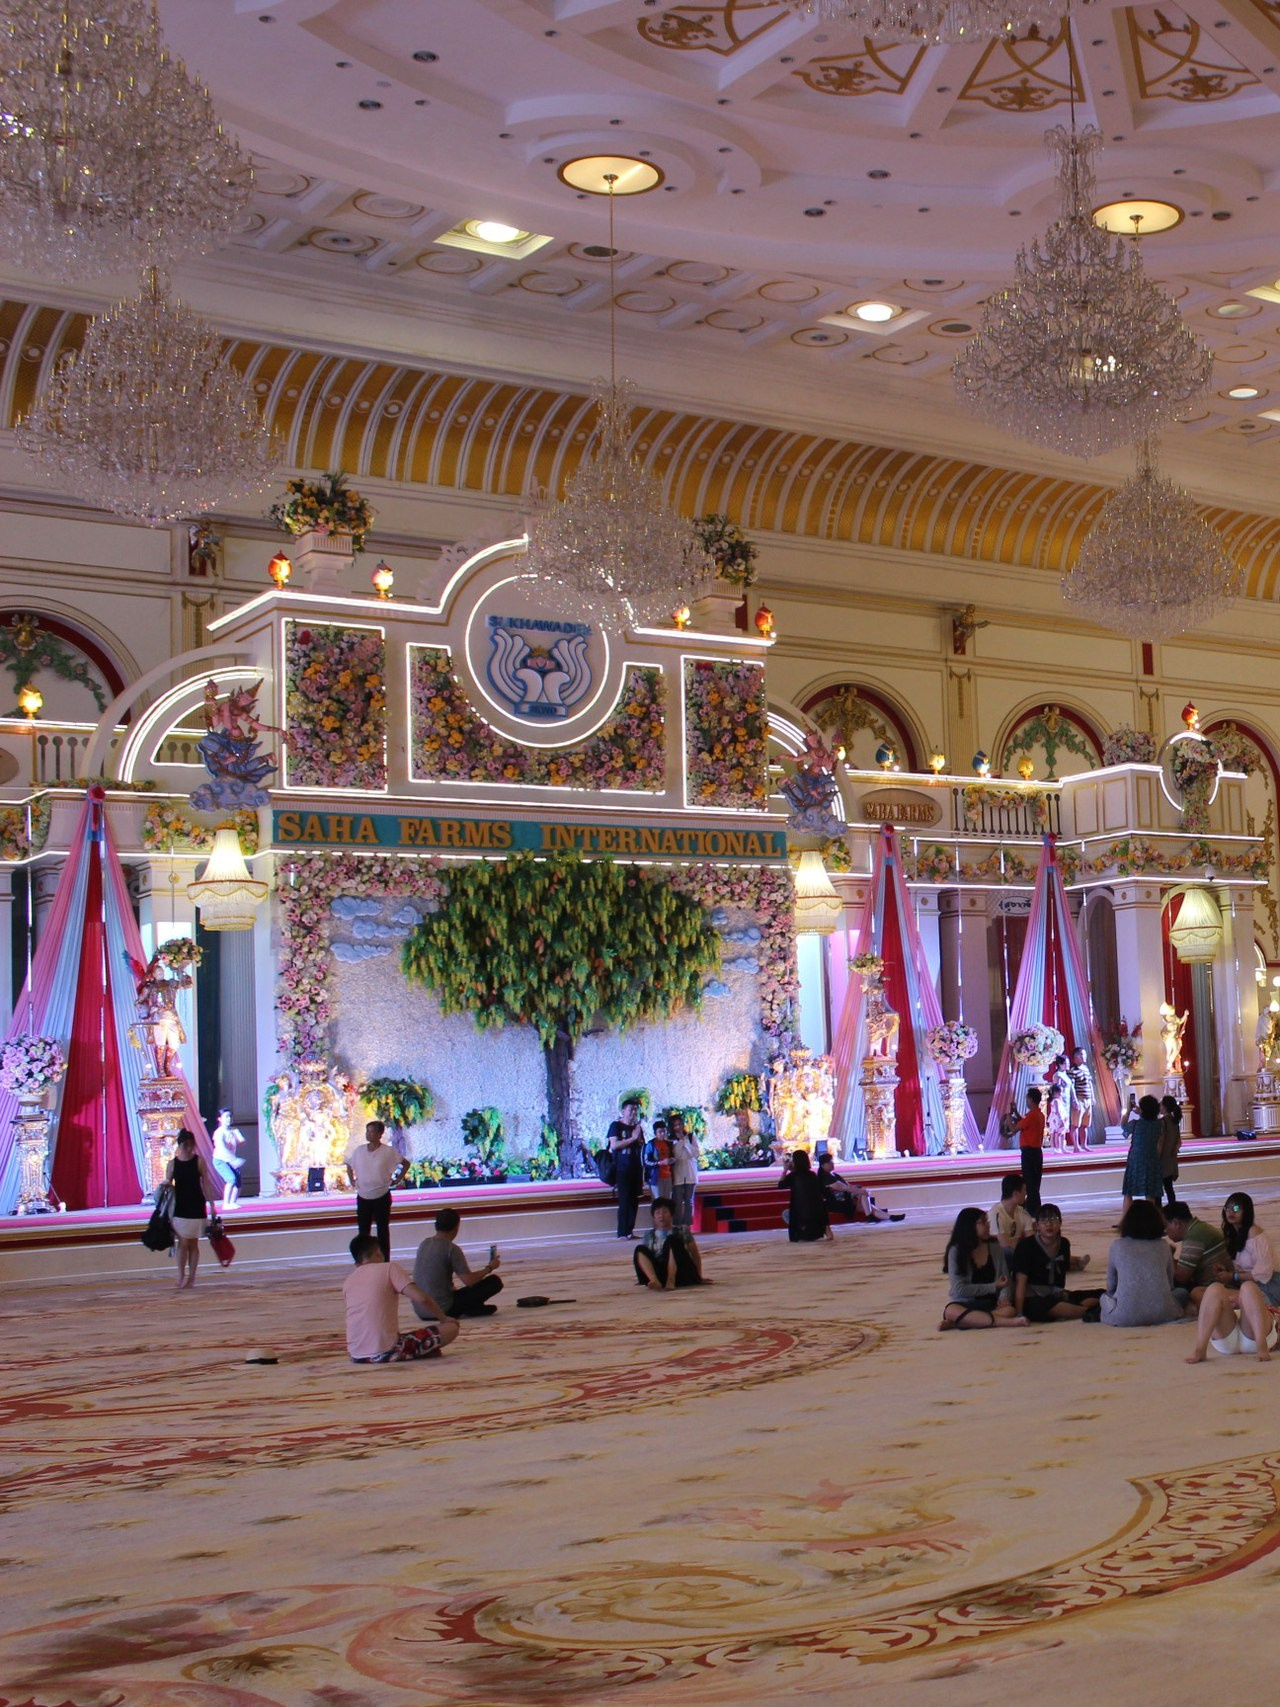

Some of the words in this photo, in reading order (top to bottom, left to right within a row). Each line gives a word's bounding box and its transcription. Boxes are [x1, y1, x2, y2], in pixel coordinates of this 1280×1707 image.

[278, 812, 379, 844] SAHA
[399, 818, 514, 848] FARMS
[540, 824, 782, 857] INTERNATIONAL
